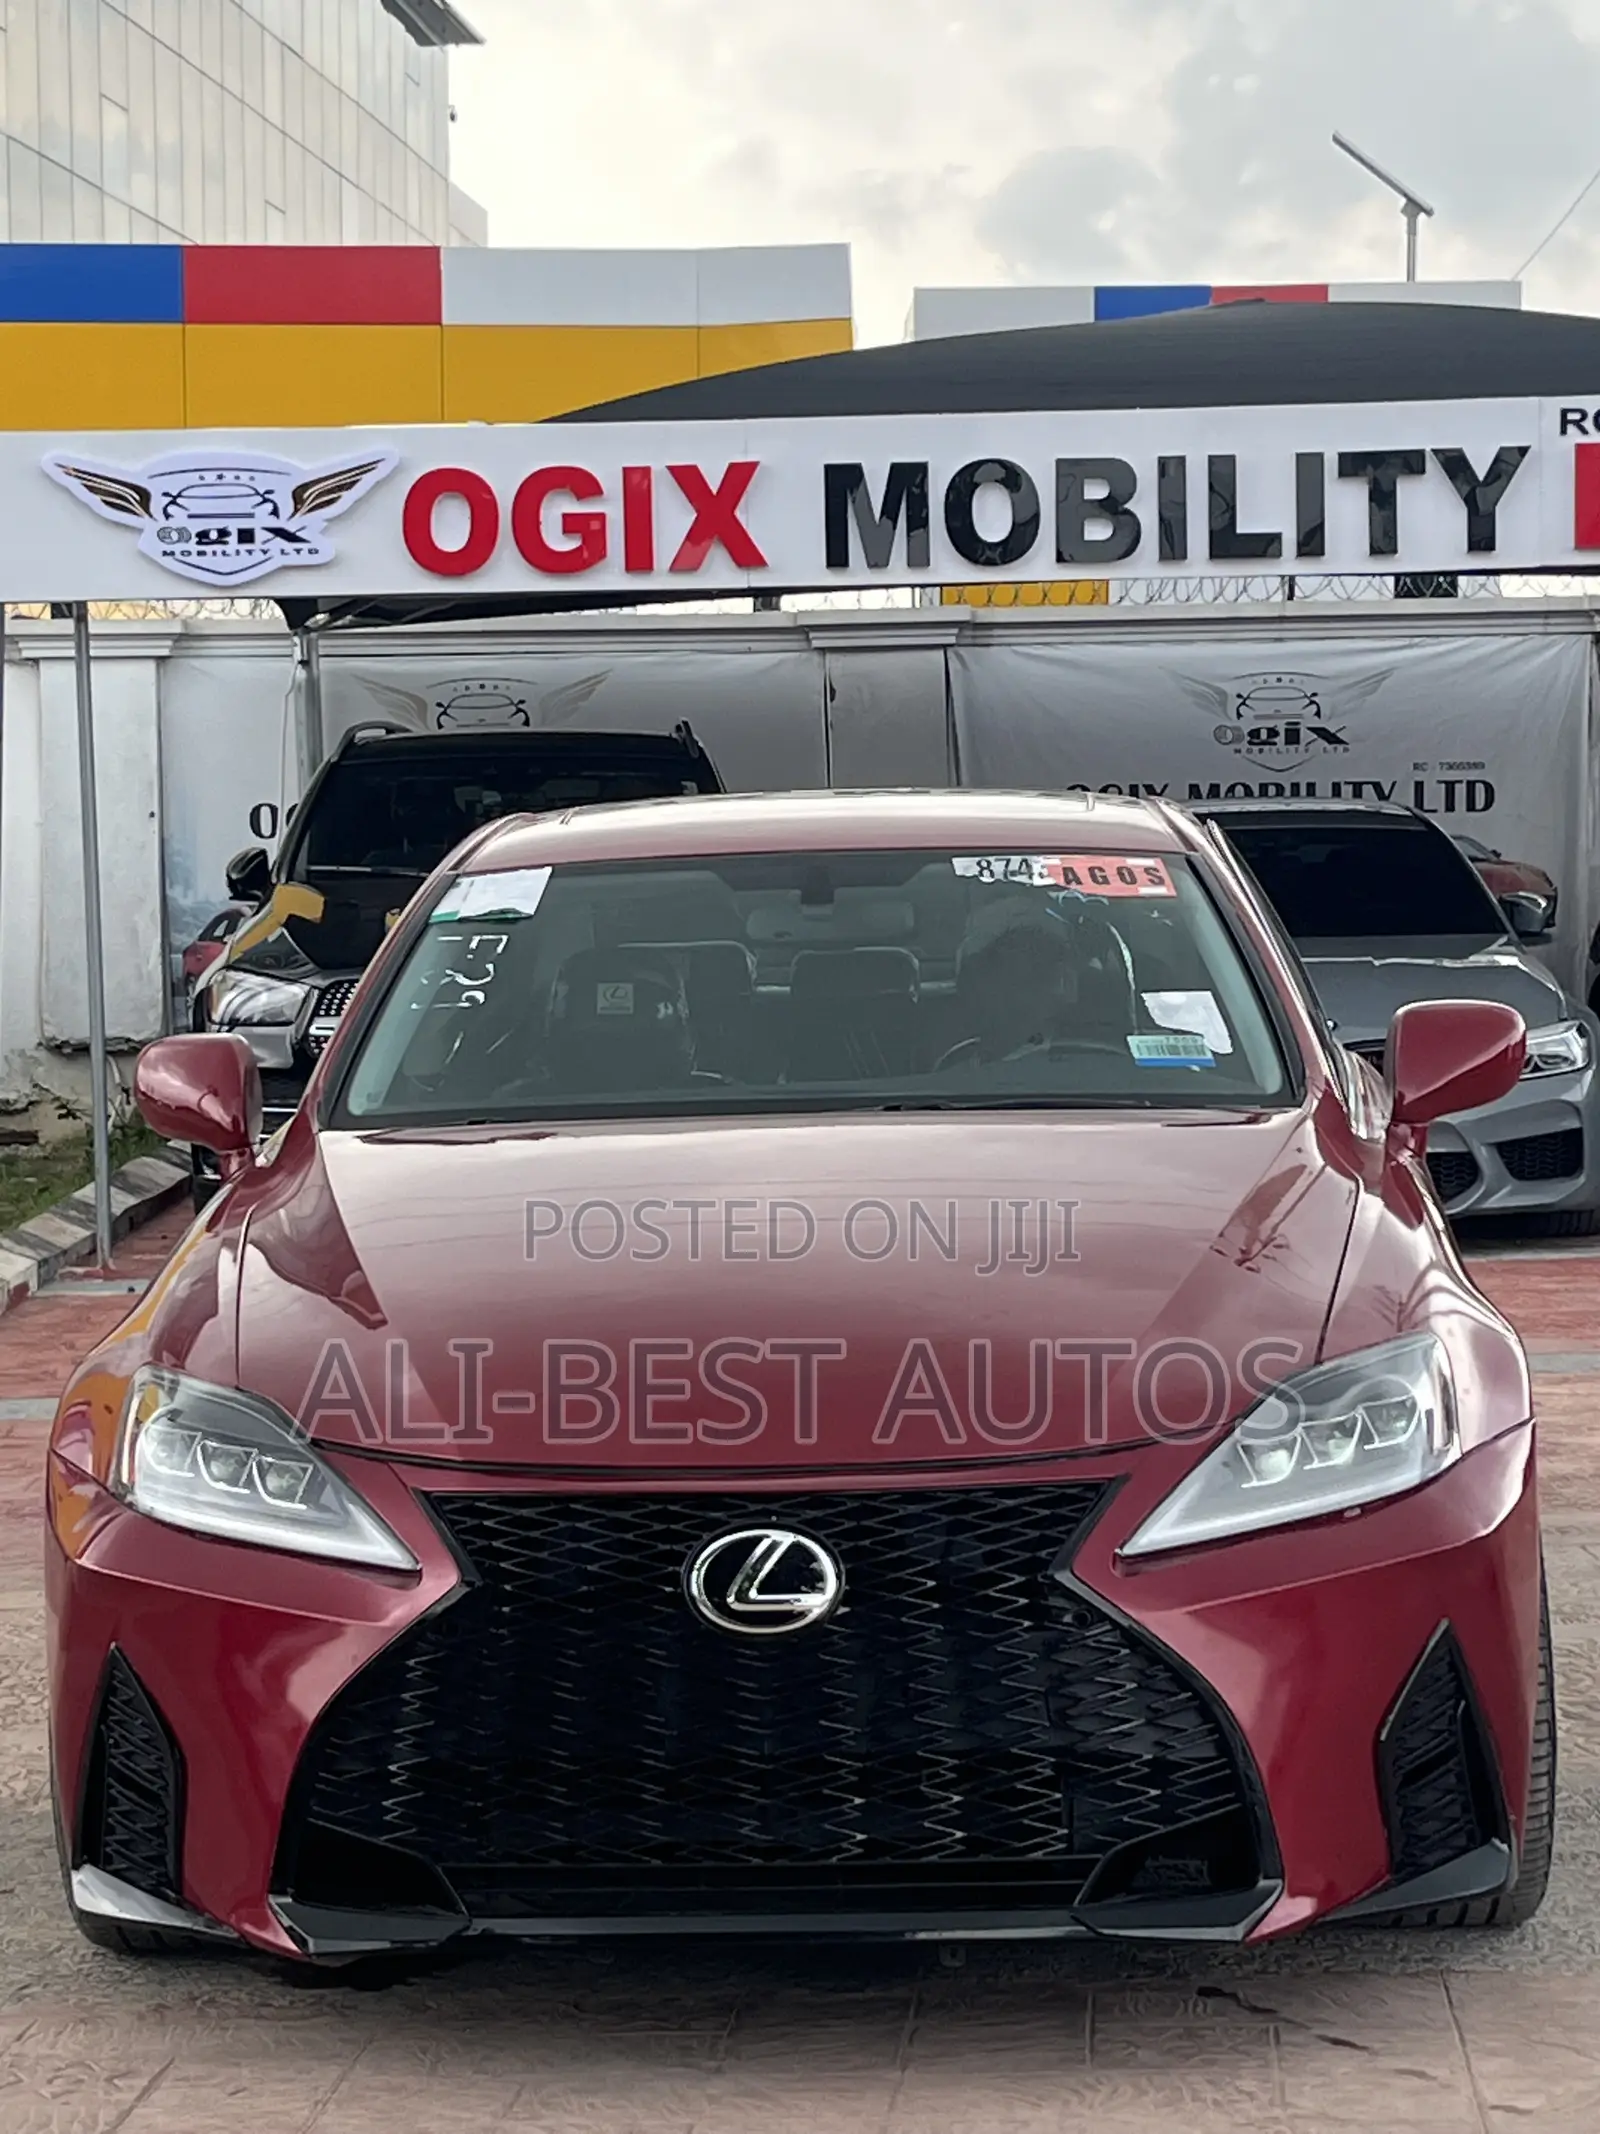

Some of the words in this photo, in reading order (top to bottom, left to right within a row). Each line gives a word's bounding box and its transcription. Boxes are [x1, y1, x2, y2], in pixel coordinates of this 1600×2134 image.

[1559, 408, 1600, 437] R
[402, 460, 770, 576] OGIX
[823, 444, 1532, 569] MOBILITY
[162, 549, 271, 558] MOBILITY
[280, 547, 320, 556] LTD
[1413, 779, 1496, 814] LTD
